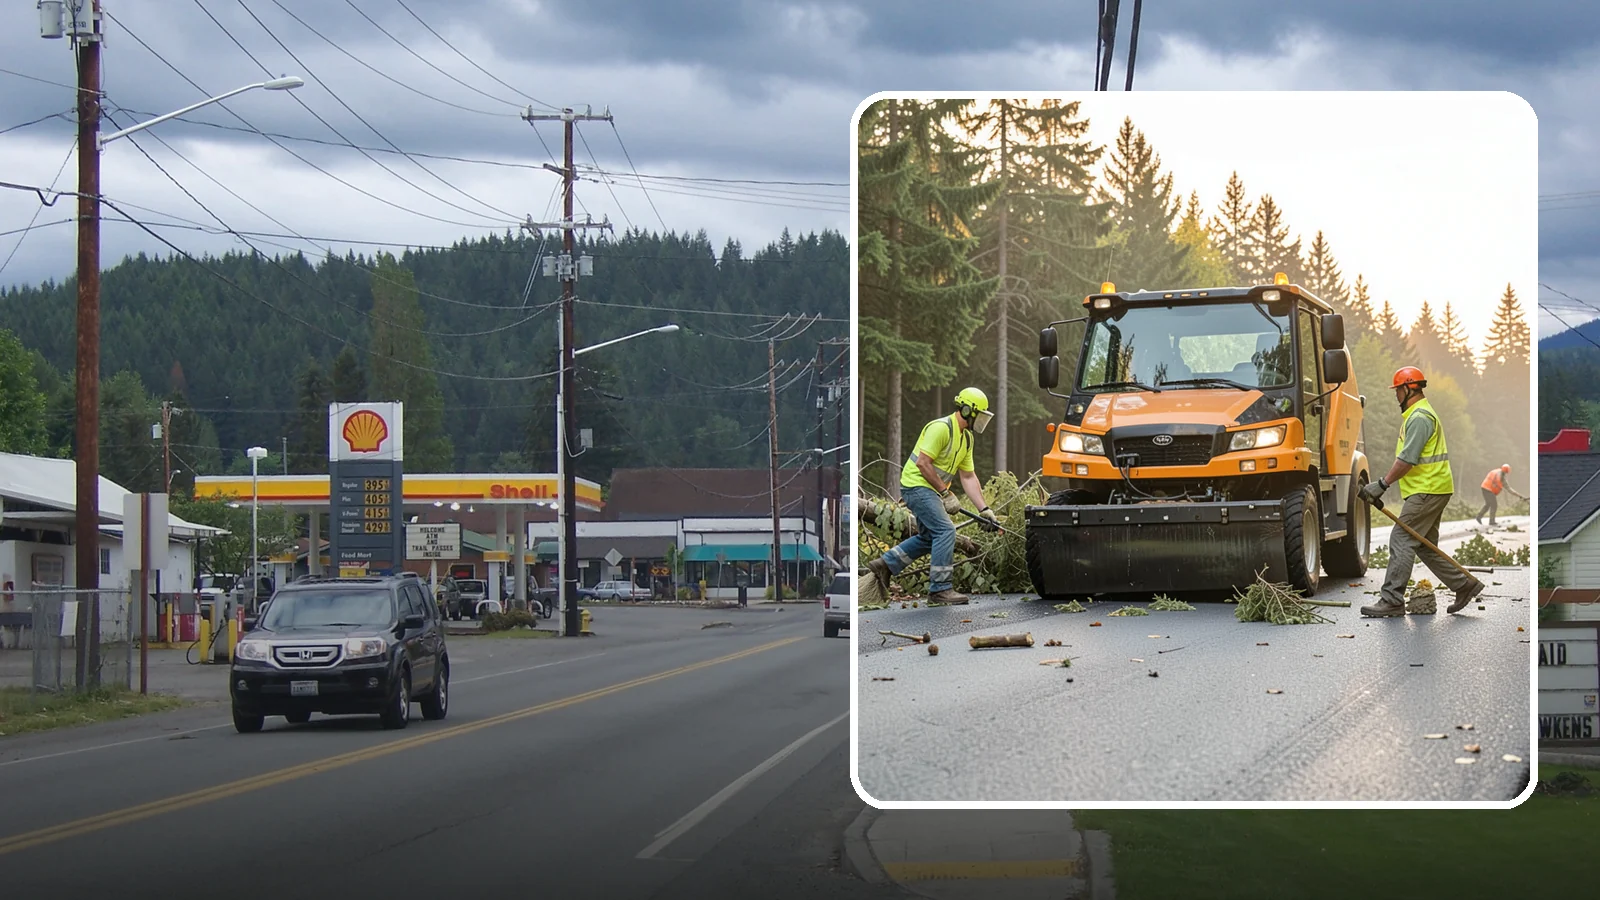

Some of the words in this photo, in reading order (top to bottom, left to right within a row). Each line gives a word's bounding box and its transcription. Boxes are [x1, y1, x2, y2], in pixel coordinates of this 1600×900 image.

[366, 480, 384, 490] 395
[490, 484, 547, 499] Shell
[366, 494, 384, 504] 405
[366, 508, 383, 518] 415
[366, 522, 383, 532] 429
